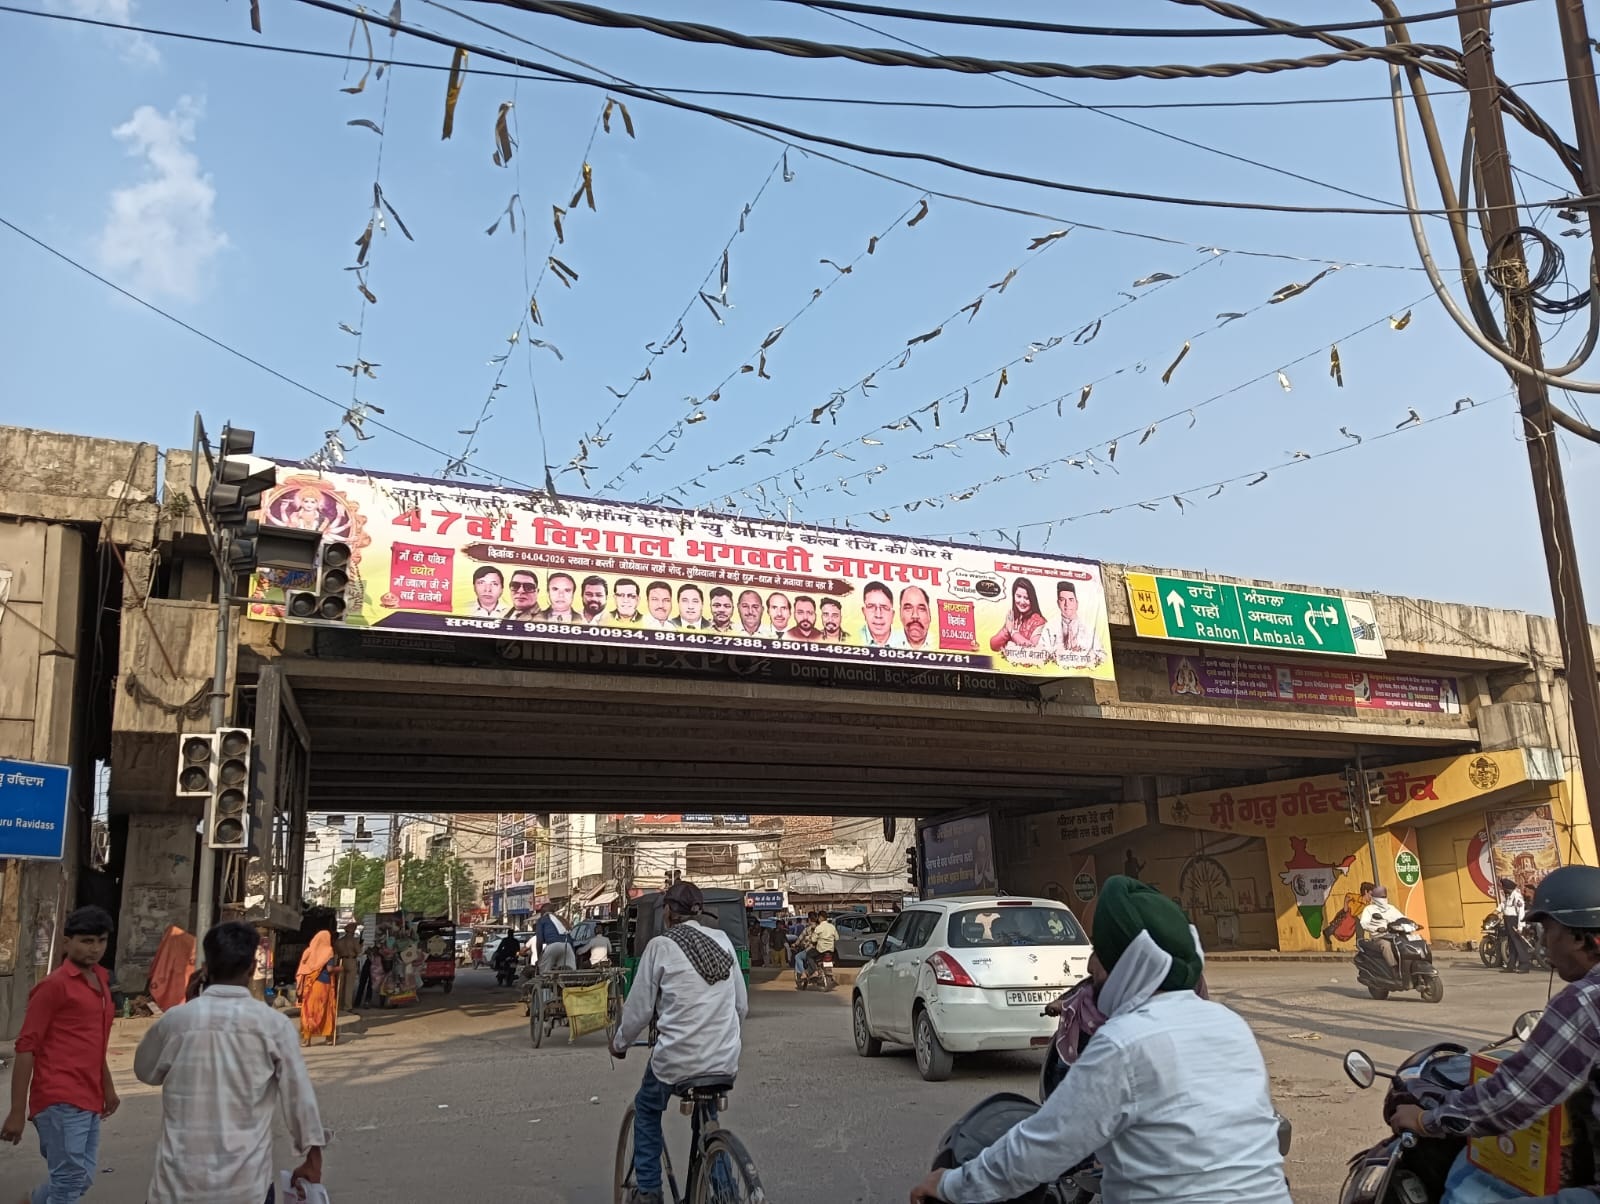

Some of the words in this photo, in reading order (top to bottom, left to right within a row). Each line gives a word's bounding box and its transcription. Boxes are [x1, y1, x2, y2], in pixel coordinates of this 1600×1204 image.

[521, 551, 565, 565] 04.04.2026
[531, 516, 674, 558] विशाल
[687, 538, 814, 573] भगवती
[823, 554, 943, 586] जागरण
[940, 549, 953, 561] से
[1138, 591, 1153, 603] NH
[1139, 603, 1155, 616] 44
[1195, 622, 1241, 641] Rahon
[1253, 627, 1306, 647] Ambala
[524, 622, 649, 641] 99886-00934,
[654, 631, 767, 650] 98140-27388,
[879, 648, 971, 665] 80547-07781
[792, 662, 829, 679] Dana
[7, 772, 45, 788] ਰਵਿਦਾਸ
[16, 818, 55, 830] Ravidass
